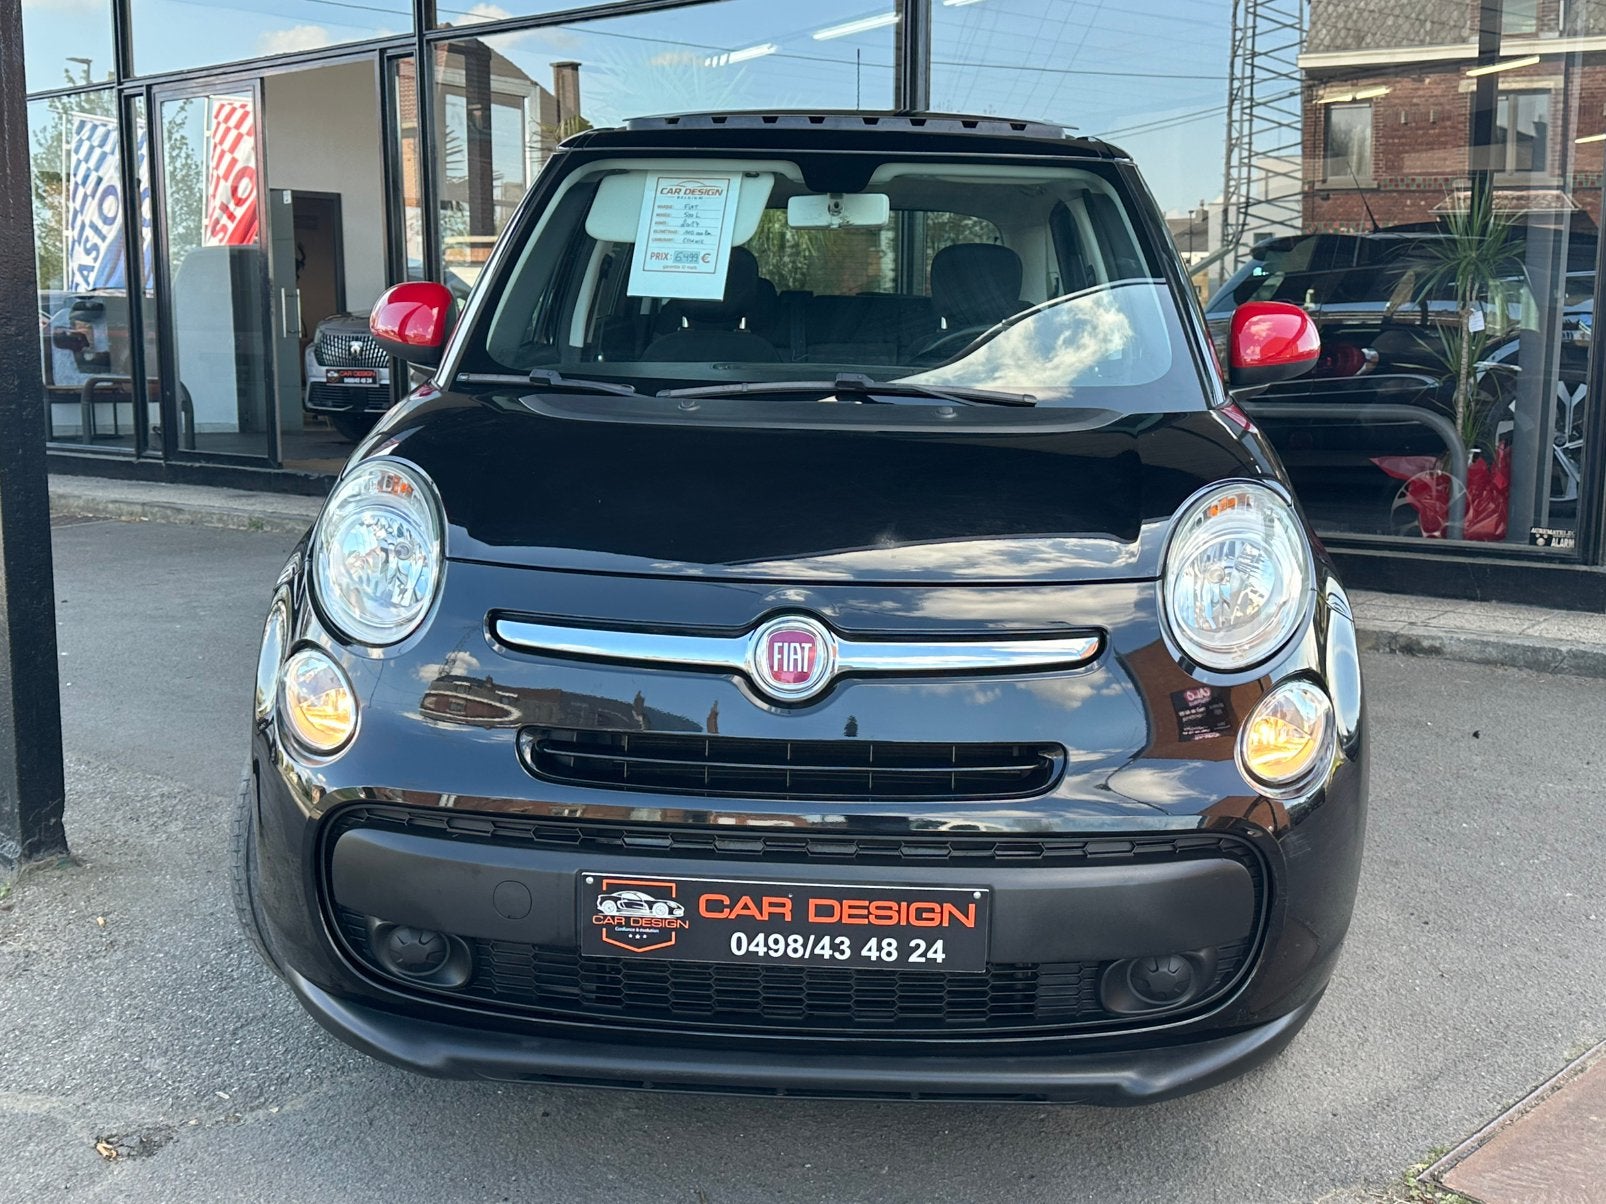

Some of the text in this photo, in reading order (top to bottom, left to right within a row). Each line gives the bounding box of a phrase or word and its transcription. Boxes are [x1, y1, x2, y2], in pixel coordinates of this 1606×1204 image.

[660, 187, 723, 196] CAR DESIGN
[701, 253, 711, 263] €
[773, 642, 812, 672] FIAT
[592, 914, 690, 929] CAR DESIGN
[699, 893, 976, 928] CAR DESIGN
[730, 931, 945, 963] 0498/43 48 24
